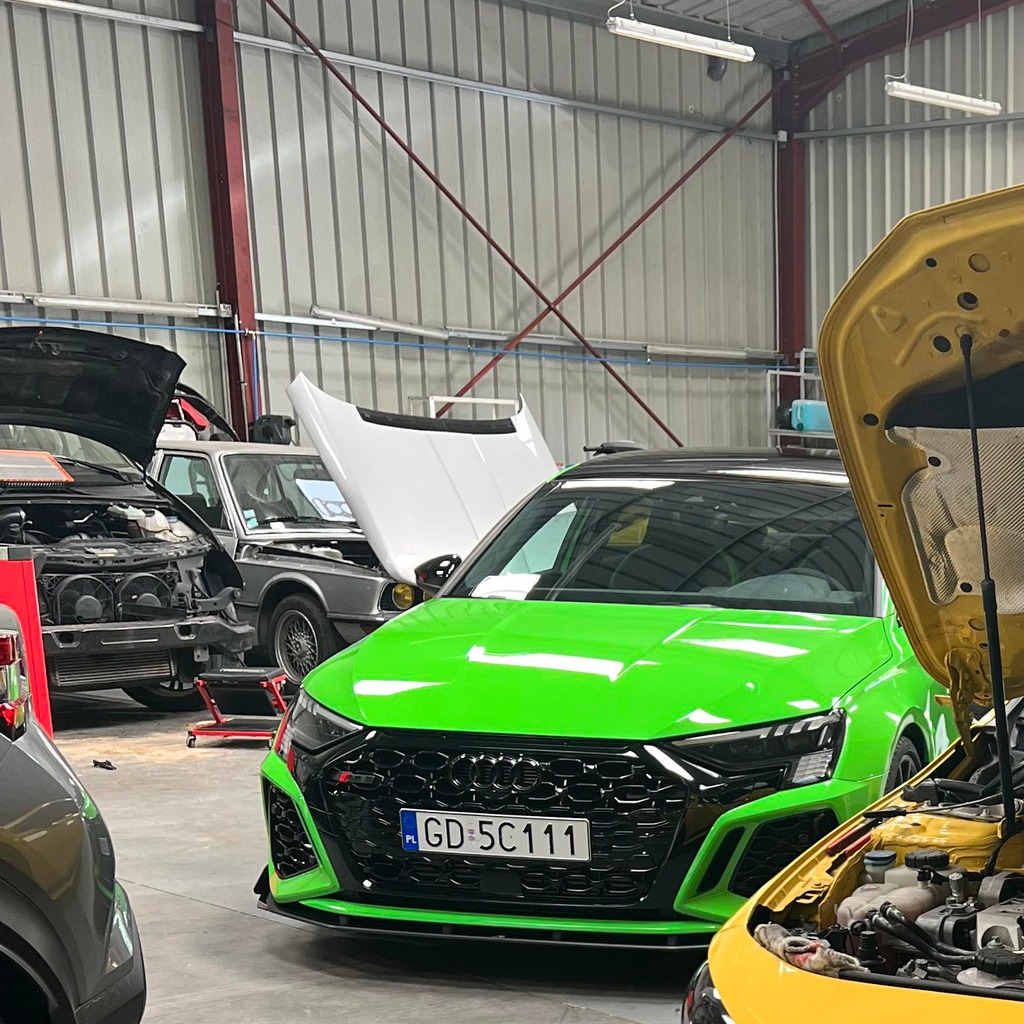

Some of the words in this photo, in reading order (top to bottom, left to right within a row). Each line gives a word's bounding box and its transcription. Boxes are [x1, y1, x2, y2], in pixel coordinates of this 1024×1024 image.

[405, 834, 417, 844] PL
[424, 817, 464, 849] GD
[478, 820, 575, 856] 5C111
